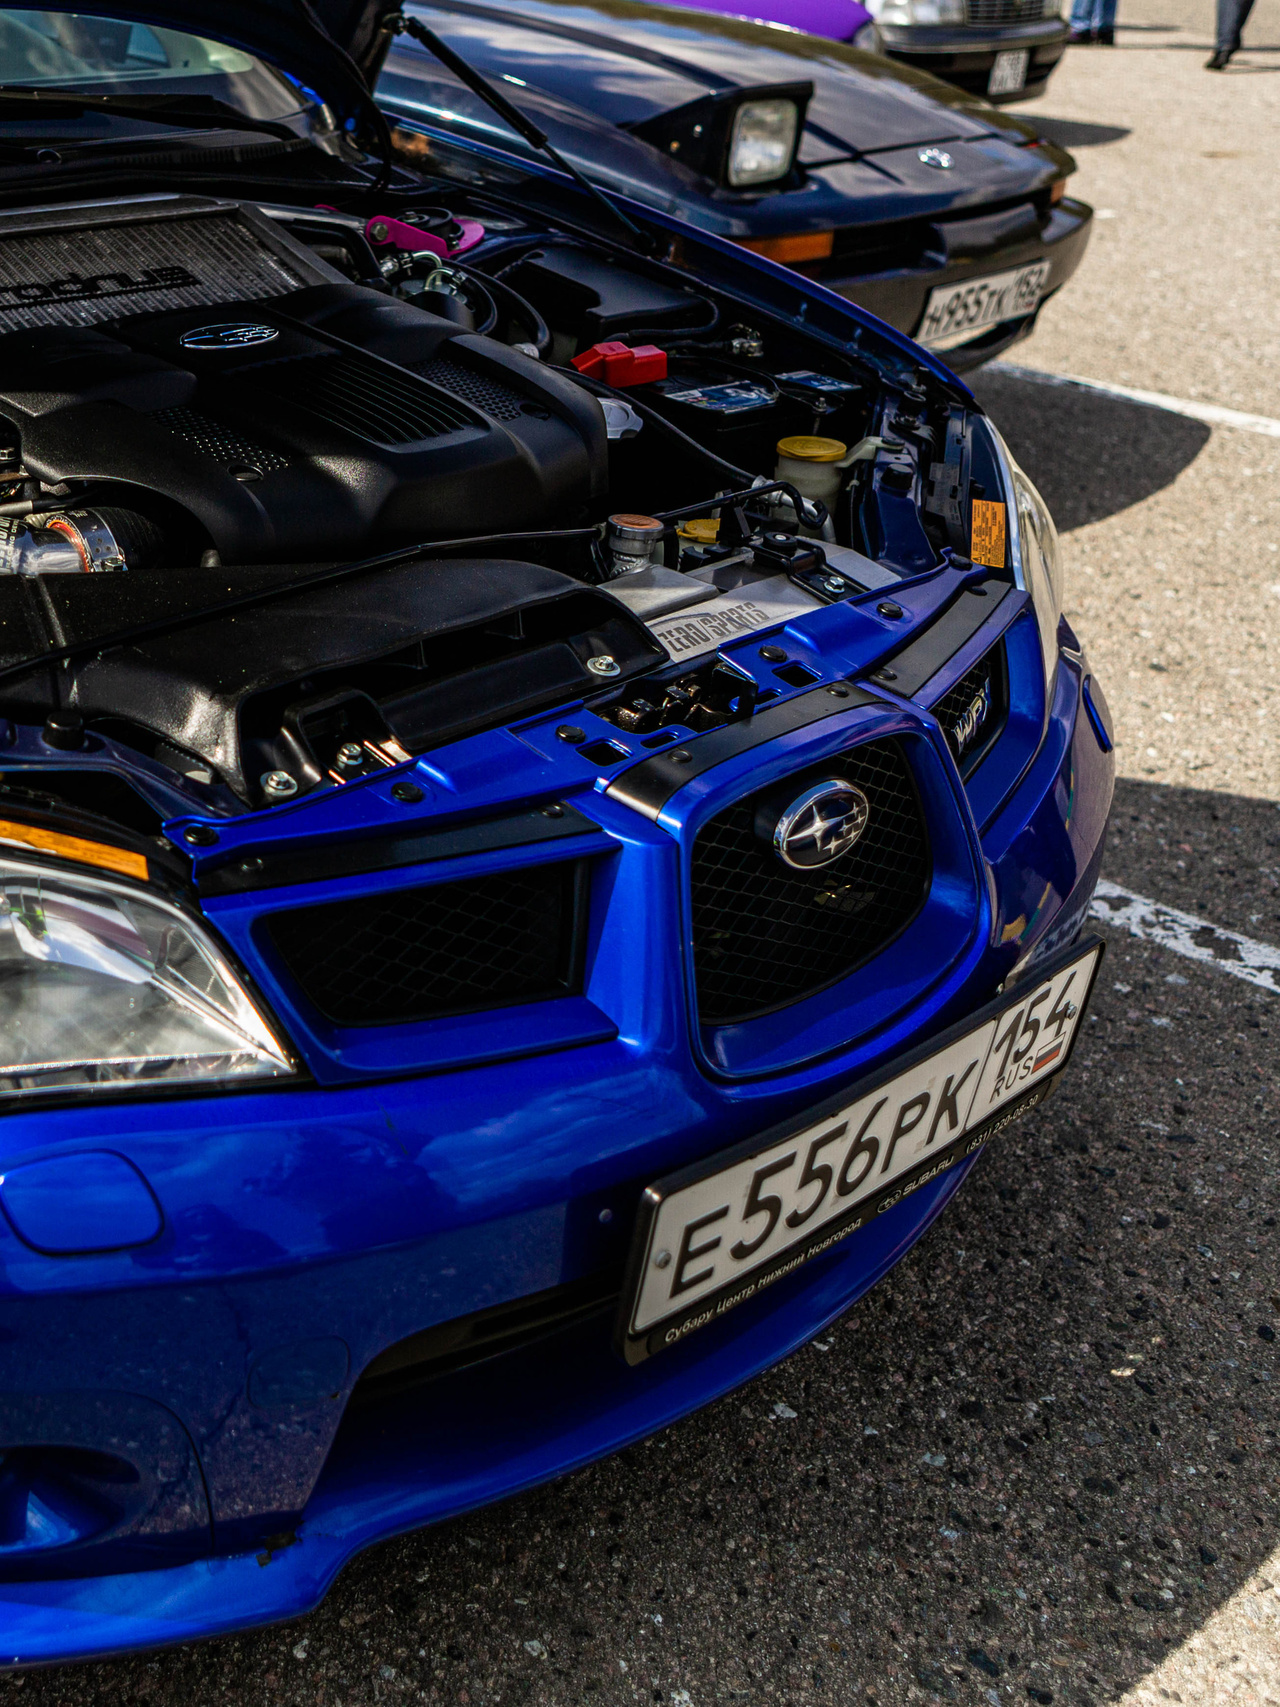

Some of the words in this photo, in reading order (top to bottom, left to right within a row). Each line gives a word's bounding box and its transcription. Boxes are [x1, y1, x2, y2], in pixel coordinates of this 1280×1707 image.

[657, 601, 770, 653] ZERO/SPORTS
[989, 1055, 1034, 1104] RUS
[669, 1059, 979, 1299] E556PK
[993, 969, 1078, 1080] 154
[902, 1155, 955, 1196] SUBARU
[664, 1308, 714, 1343] Субару
[716, 1284, 755, 1312] Центр
[757, 1252, 804, 1288] Нижний
[807, 1217, 862, 1258] Новгород
